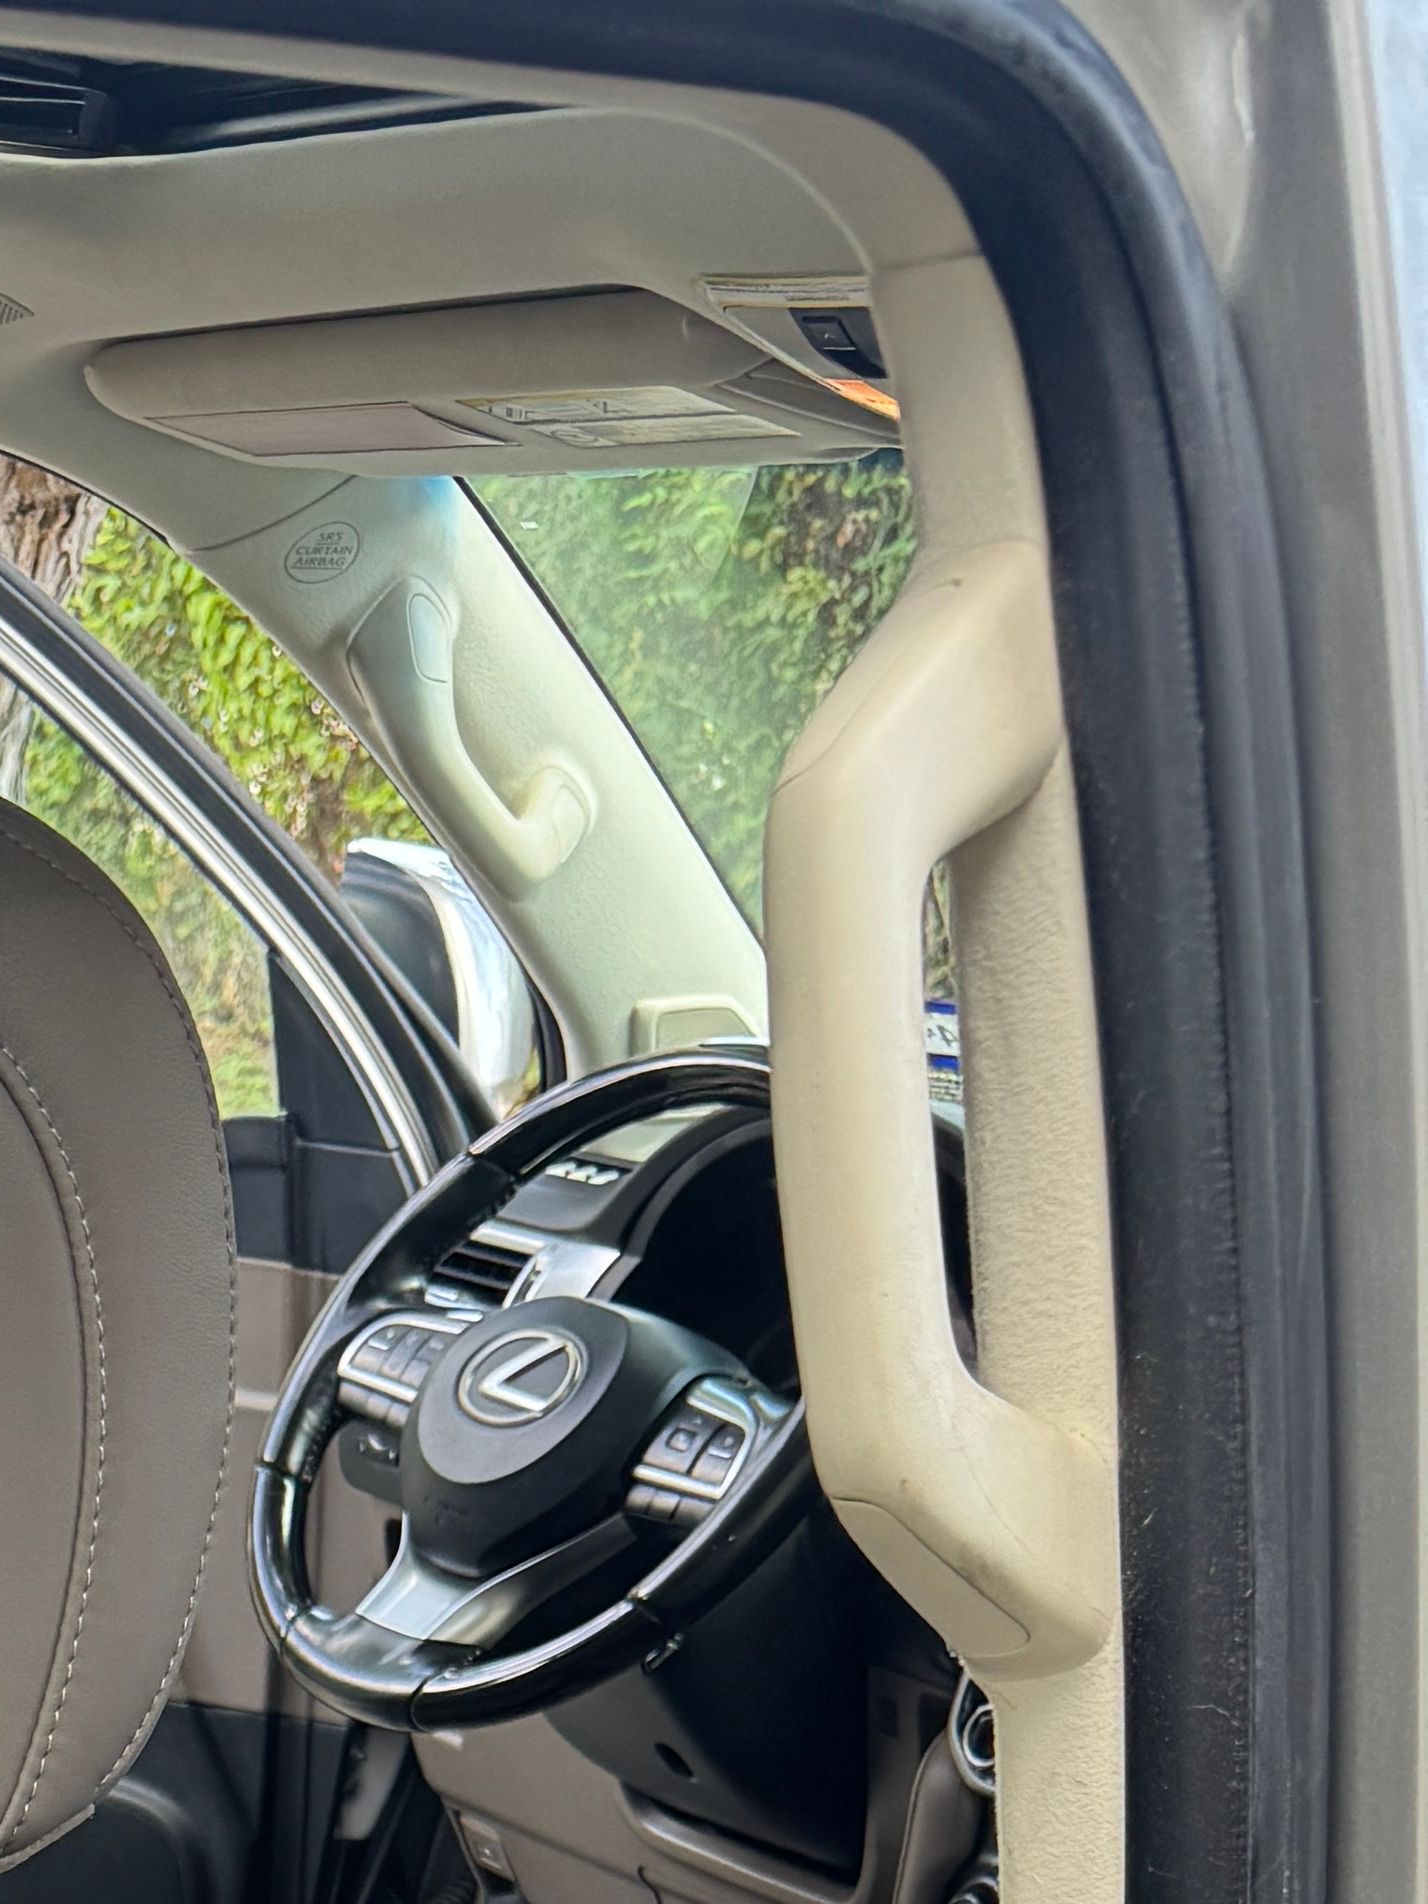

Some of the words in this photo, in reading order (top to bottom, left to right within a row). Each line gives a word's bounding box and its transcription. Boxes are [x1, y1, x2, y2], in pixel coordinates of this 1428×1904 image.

[317, 532, 344, 541] SRS
[295, 545, 353, 555] CURTAIN
[293, 557, 346, 566] AIRBAG
